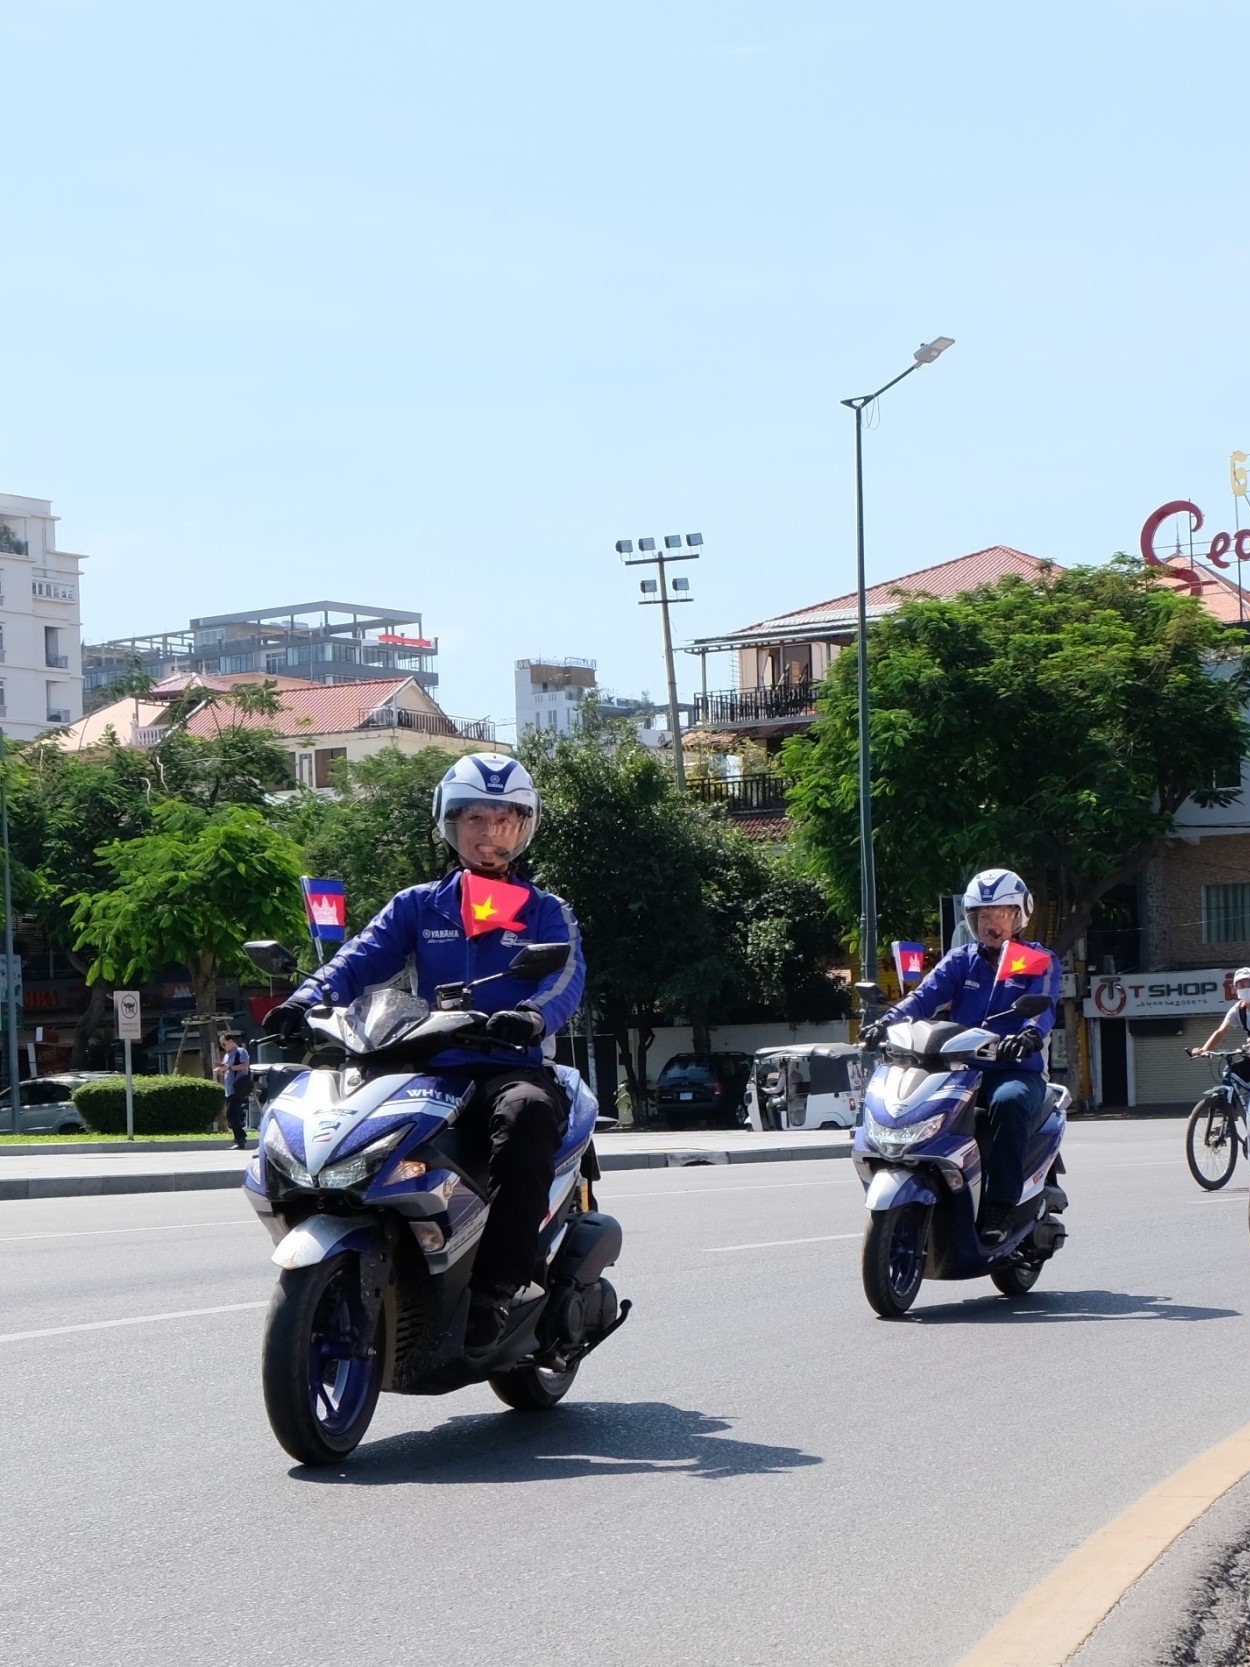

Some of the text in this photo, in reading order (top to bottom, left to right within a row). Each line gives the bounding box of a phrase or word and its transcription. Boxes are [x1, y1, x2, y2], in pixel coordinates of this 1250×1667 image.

[430, 929, 460, 938] YAMAHA
[1128, 985, 1145, 998] T
[1148, 982, 1218, 998] SHOP
[406, 1088, 443, 1099] WHY
